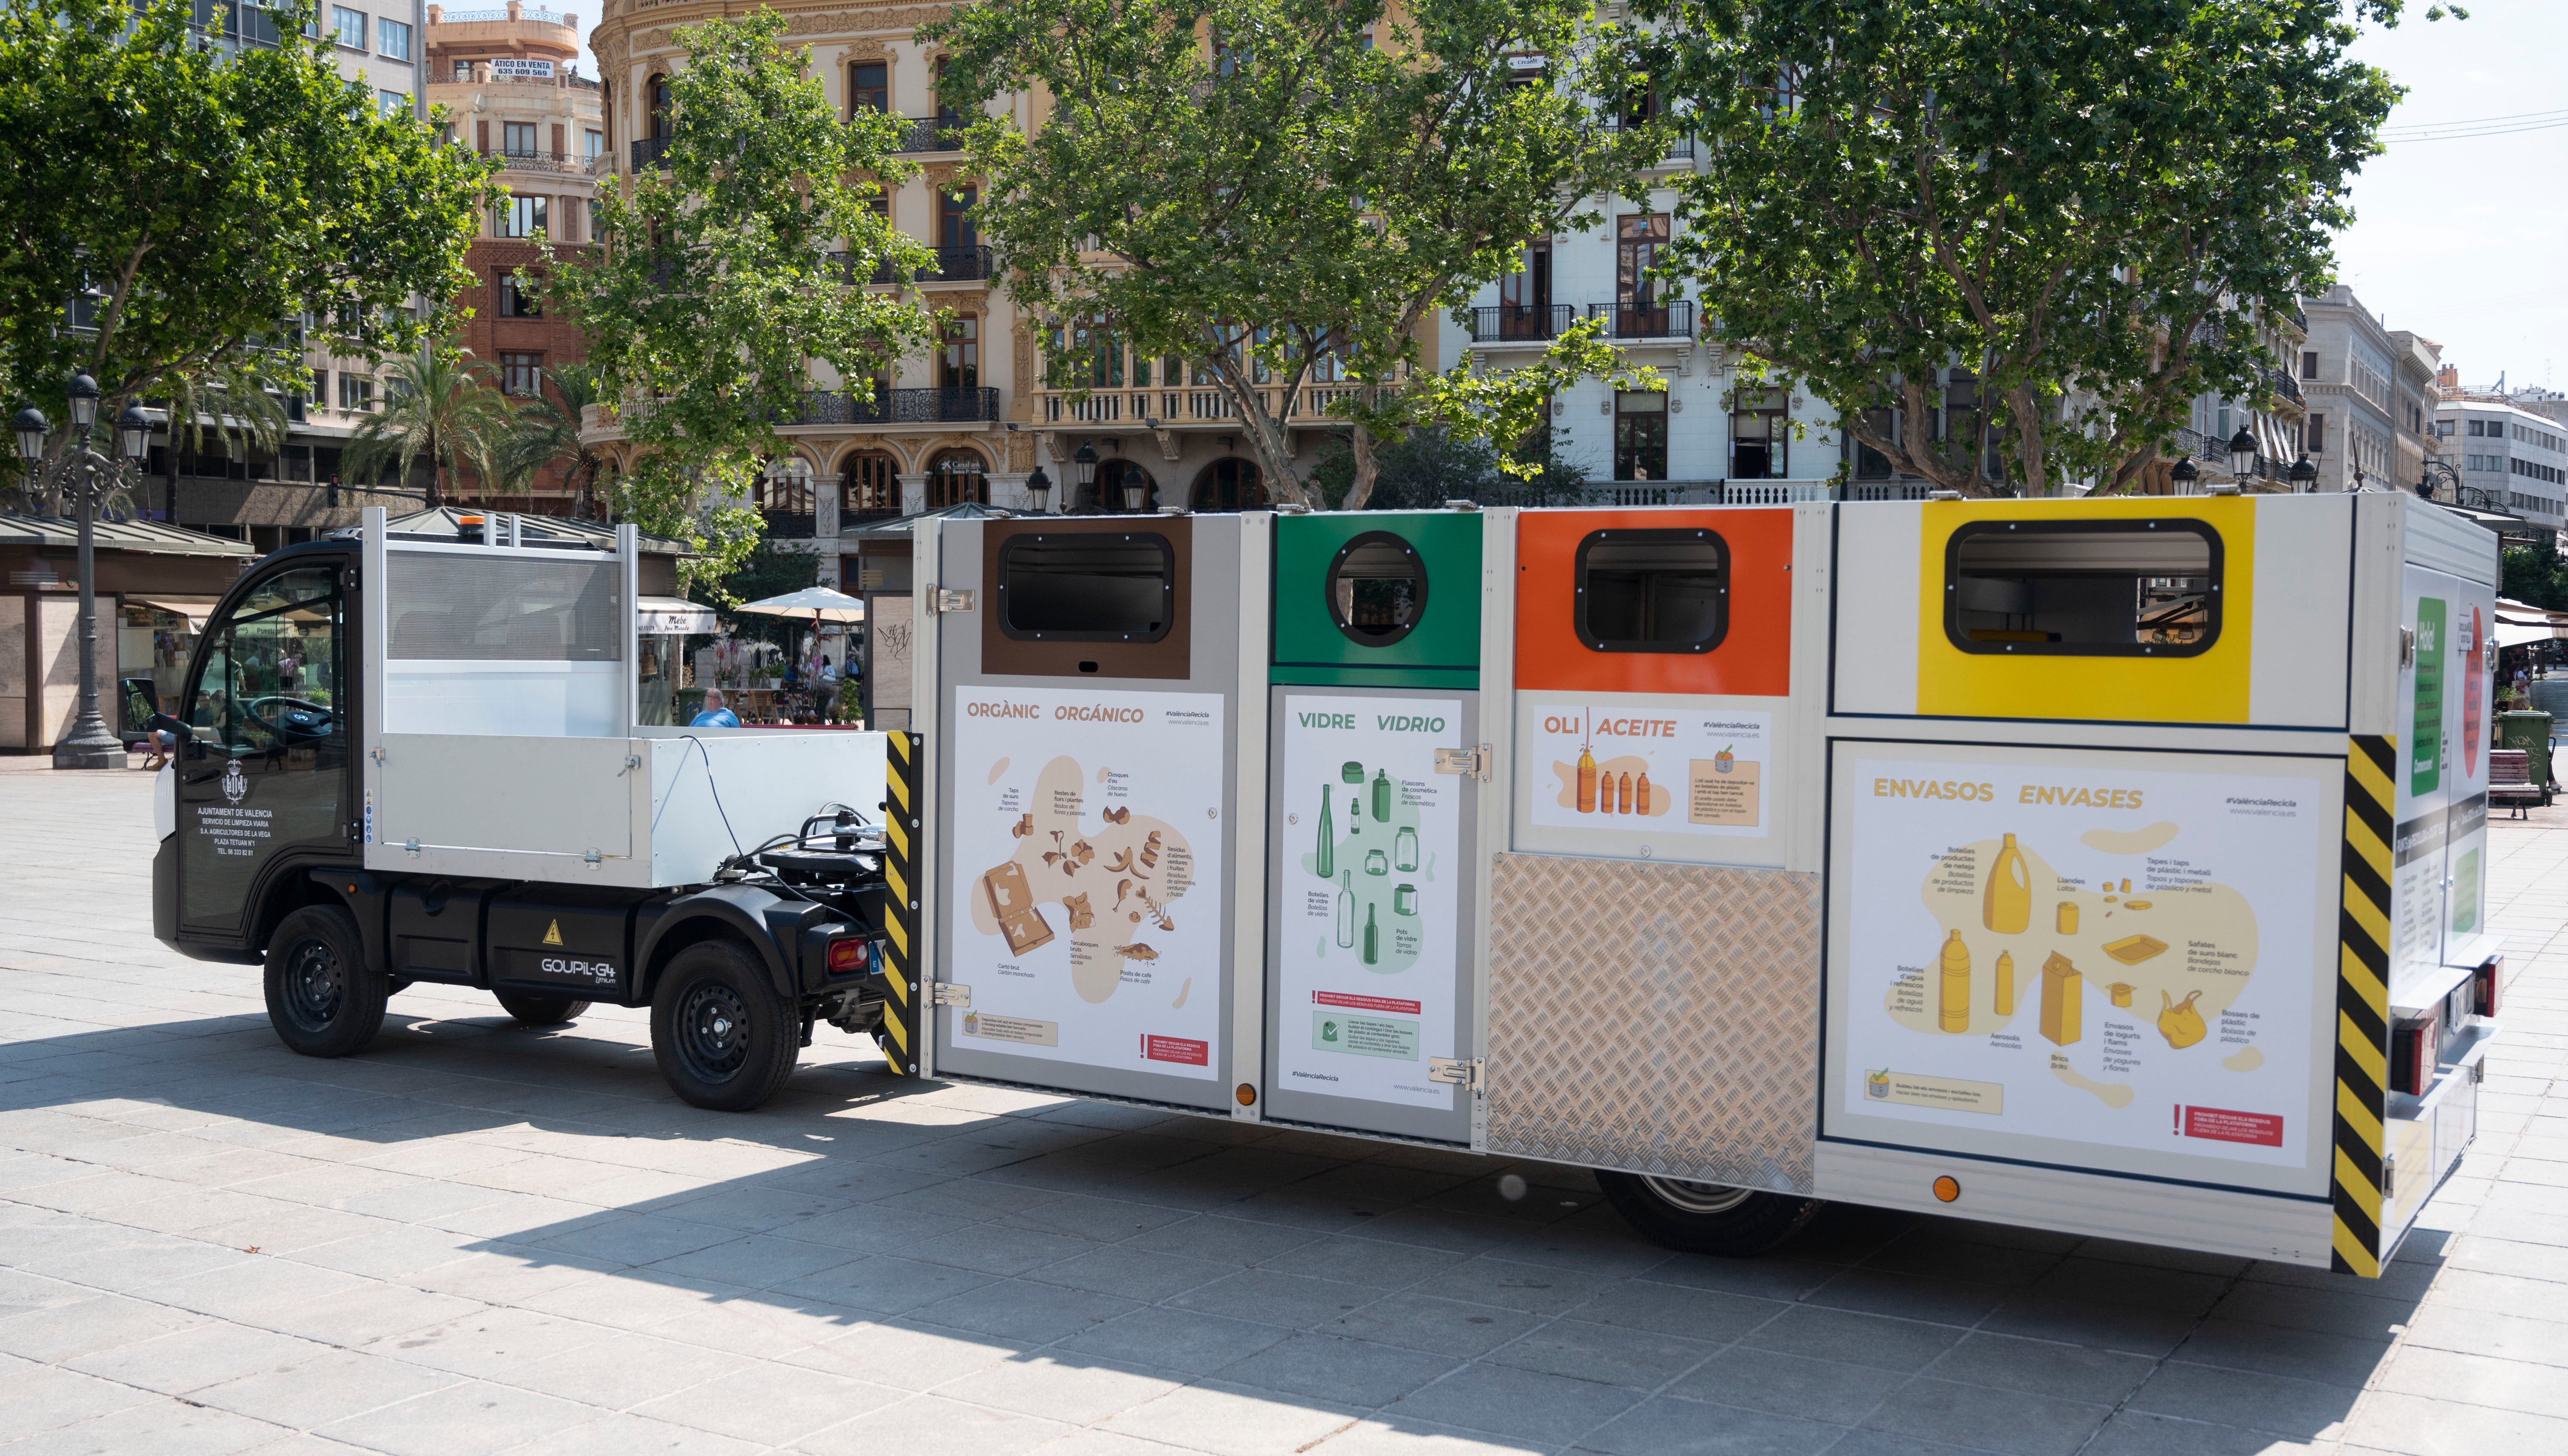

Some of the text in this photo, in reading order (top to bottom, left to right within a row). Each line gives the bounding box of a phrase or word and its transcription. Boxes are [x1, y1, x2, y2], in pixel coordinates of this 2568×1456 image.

[669, 615, 687, 624] Mebe
[967, 700, 1144, 723] ORGÀNIC ORGÁNICO
[1298, 712, 1445, 733] VIDRE VIDRIO
[1544, 716, 1676, 737] OLI ACEITE
[1874, 778, 2143, 809] ENVASOS ENVASES
[2226, 798, 2297, 807] #ValènciaRecicla
[198, 807, 235, 816] AJUNTAMENT
[244, 809, 273, 818] VALENCIA
[1990, 1033, 2020, 1041] Aerosols
[1989, 1041, 2022, 1050] Aerosoles
[1292, 1071, 1338, 1081] #ValènciaRecicla
[1394, 1085, 1440, 1094] www.valencia.es
